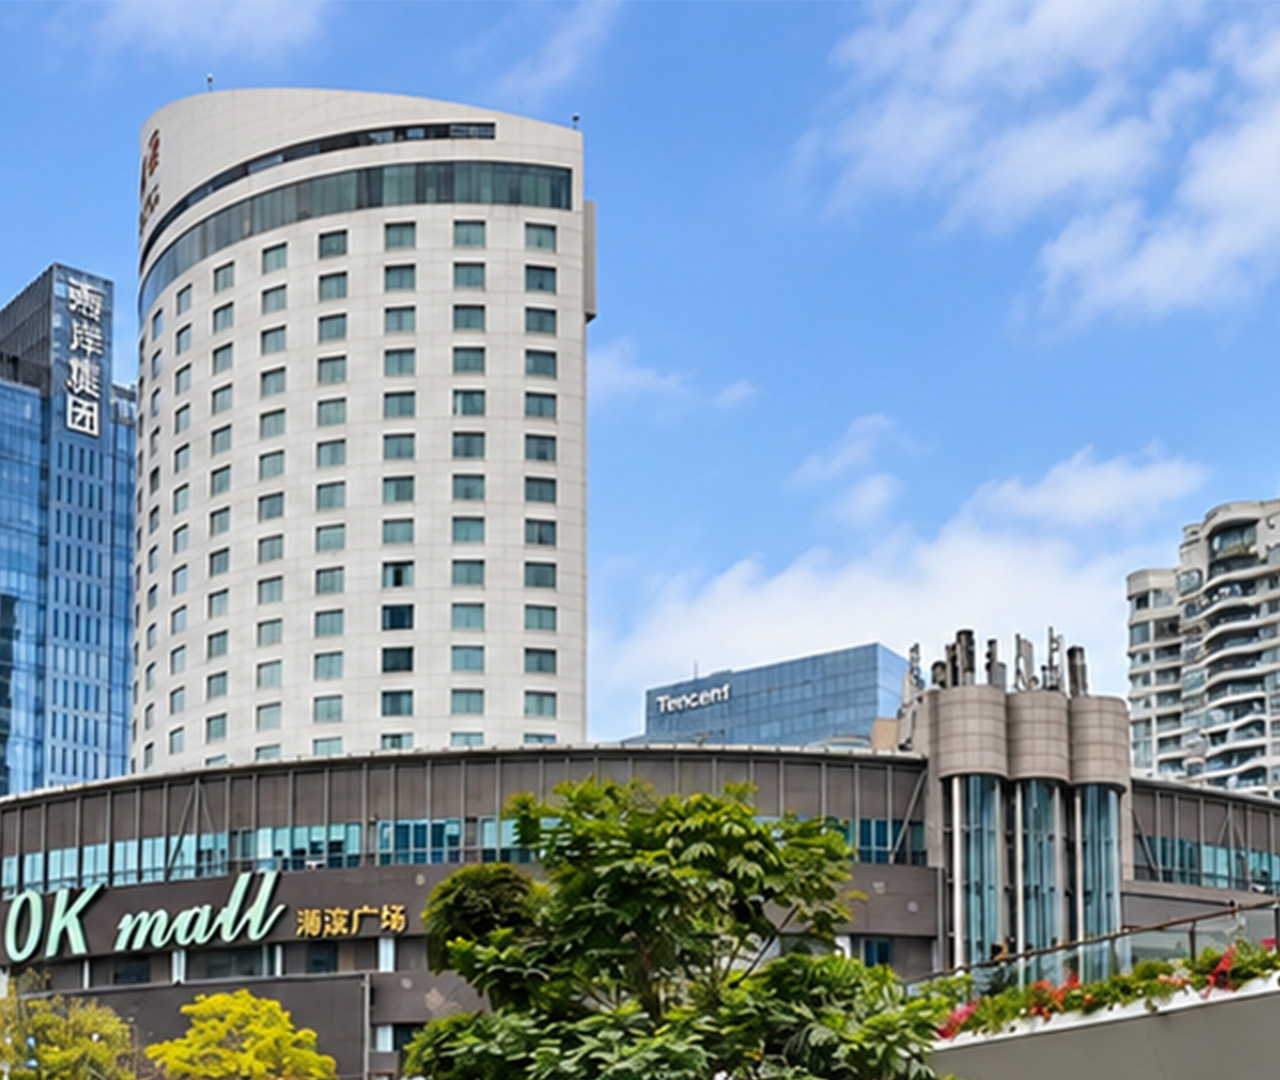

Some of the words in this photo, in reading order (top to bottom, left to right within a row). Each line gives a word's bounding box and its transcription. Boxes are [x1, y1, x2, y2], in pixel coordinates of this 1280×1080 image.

[656, 683, 730, 713] Tencent
[5, 883, 102, 962] OK
[114, 869, 286, 951] mall
